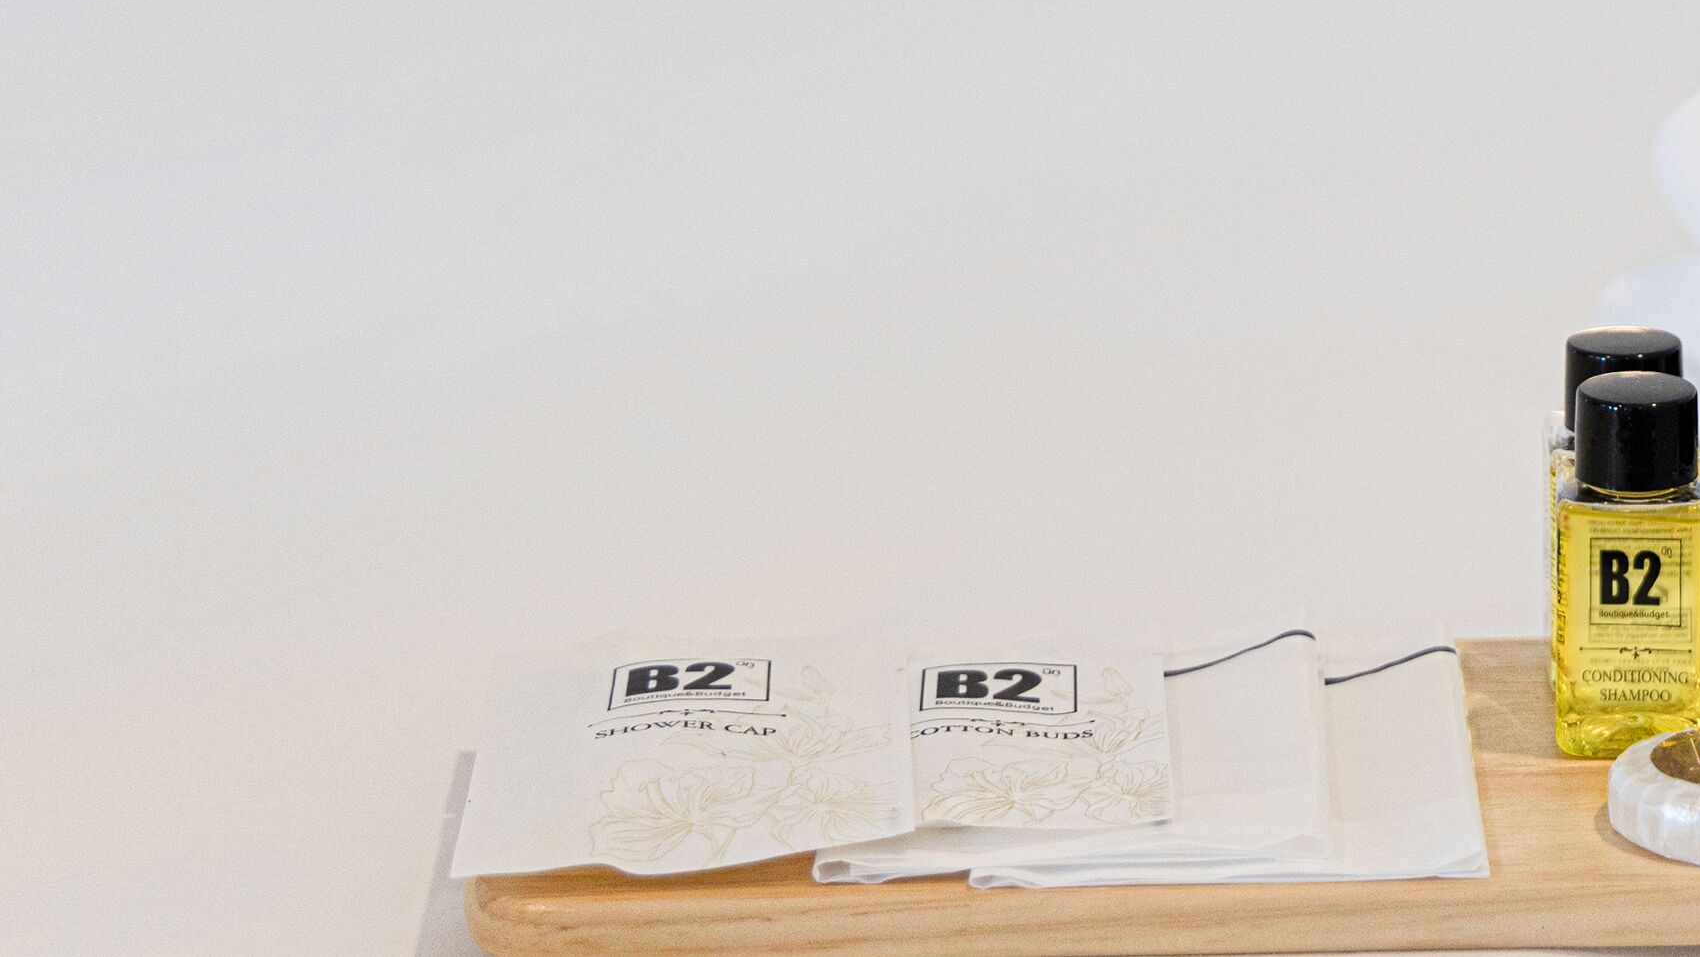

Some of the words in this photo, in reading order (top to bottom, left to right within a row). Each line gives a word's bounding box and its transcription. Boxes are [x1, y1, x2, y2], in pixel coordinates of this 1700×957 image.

[1600, 549, 1662, 606] B2
[1598, 609, 1669, 620] Boutique&Budget
[624, 661, 736, 697] B2
[1581, 669, 1689, 685] CONDITIONING
[935, 667, 1043, 703] B2
[623, 690, 747, 703] Boutique&Budget
[1599, 688, 1673, 703] SHAMPOO
[934, 699, 1056, 711] Boutique&Budget
[594, 719, 718, 740] SHOWER
[724, 723, 777, 737] CAP
[1025, 729, 1094, 740] BUDS
